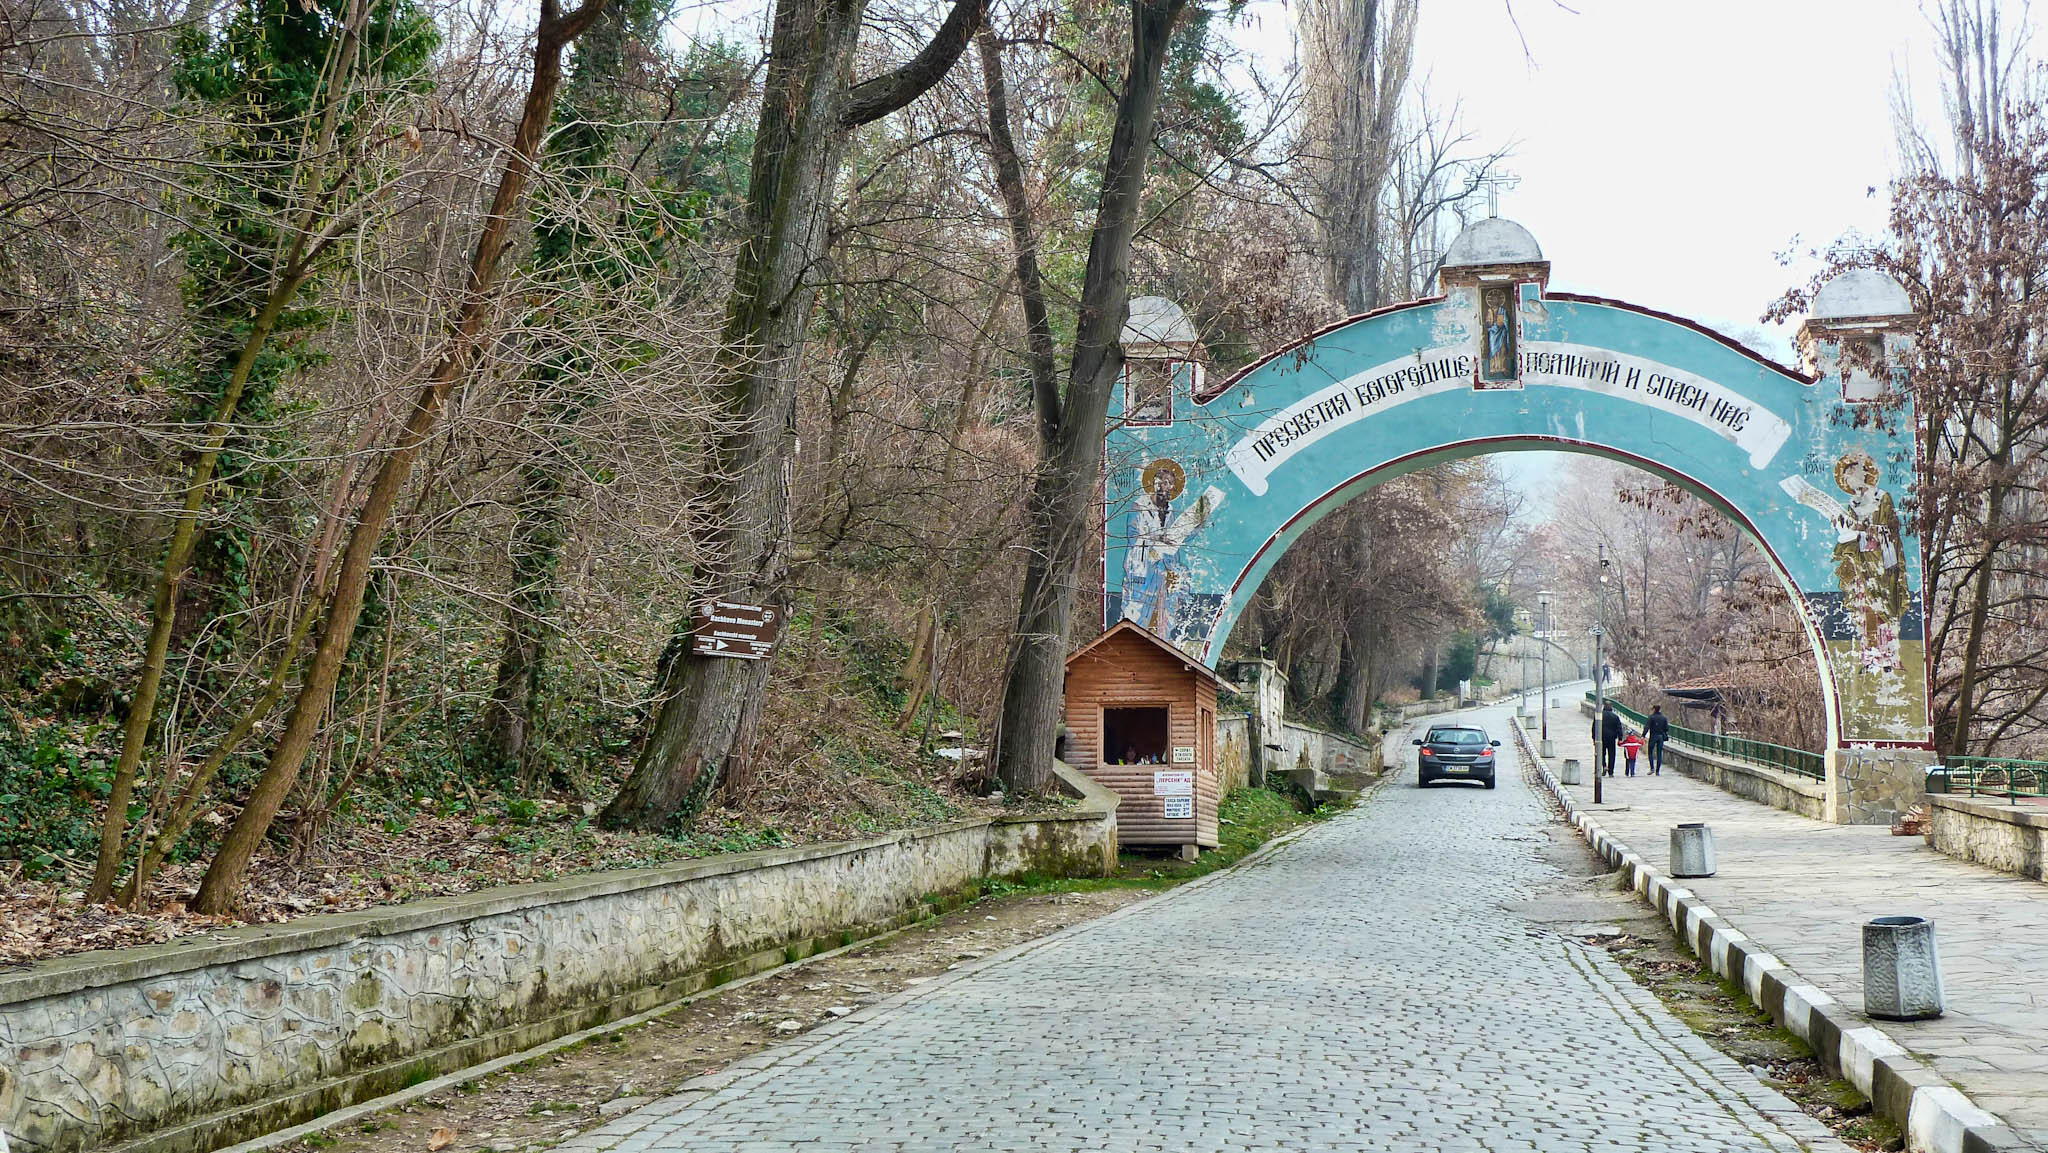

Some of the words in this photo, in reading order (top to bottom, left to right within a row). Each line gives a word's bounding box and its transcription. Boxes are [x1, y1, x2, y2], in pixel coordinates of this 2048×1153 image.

[1354, 355, 1471, 407] БОГОРОДИЦЕ
[1625, 367, 1641, 391] И
[1646, 373, 1709, 412] СПАСИ
[1710, 397, 1751, 433] НАС
